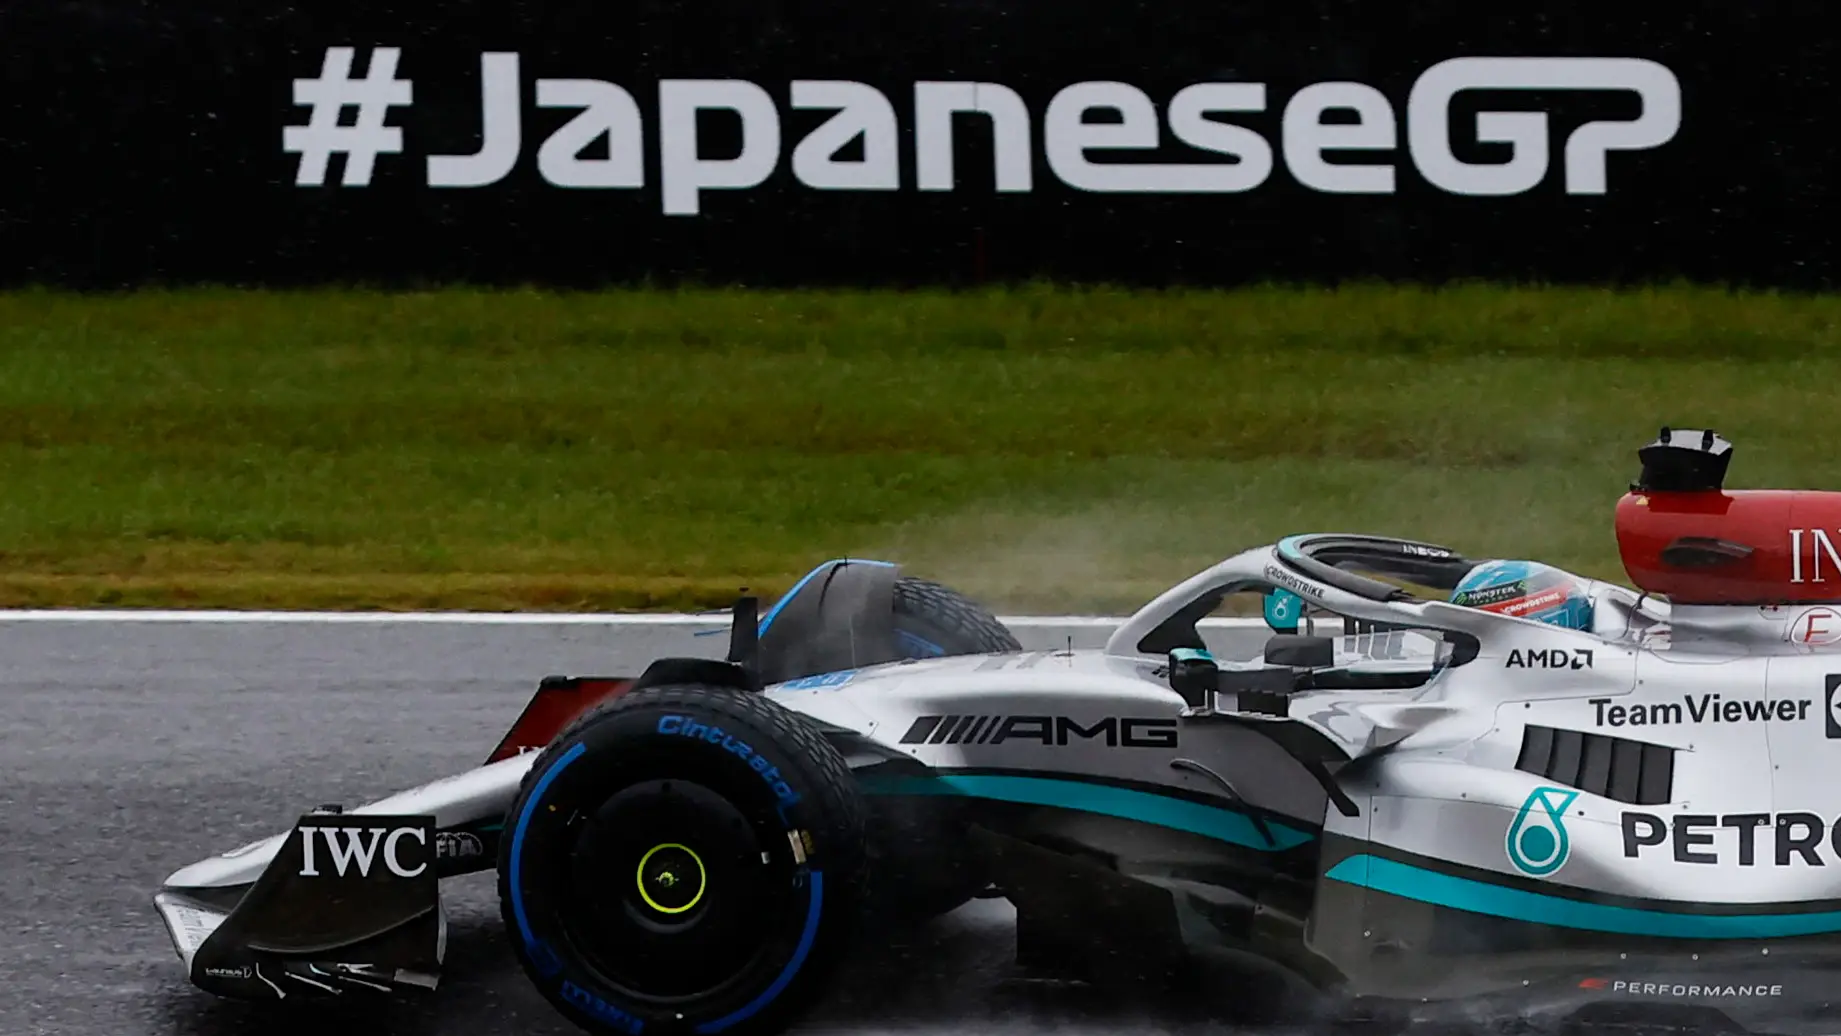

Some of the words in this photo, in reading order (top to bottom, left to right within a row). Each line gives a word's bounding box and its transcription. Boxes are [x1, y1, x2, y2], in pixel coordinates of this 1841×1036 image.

[283, 46, 1682, 215] #JapaneseGP
[1267, 566, 1325, 598] CROWDSTRIKE
[1505, 649, 1570, 669] AMD
[1588, 693, 1812, 727] TeamViewer
[298, 826, 427, 878] IWC
[1613, 980, 1782, 996] PERFORMANCE
